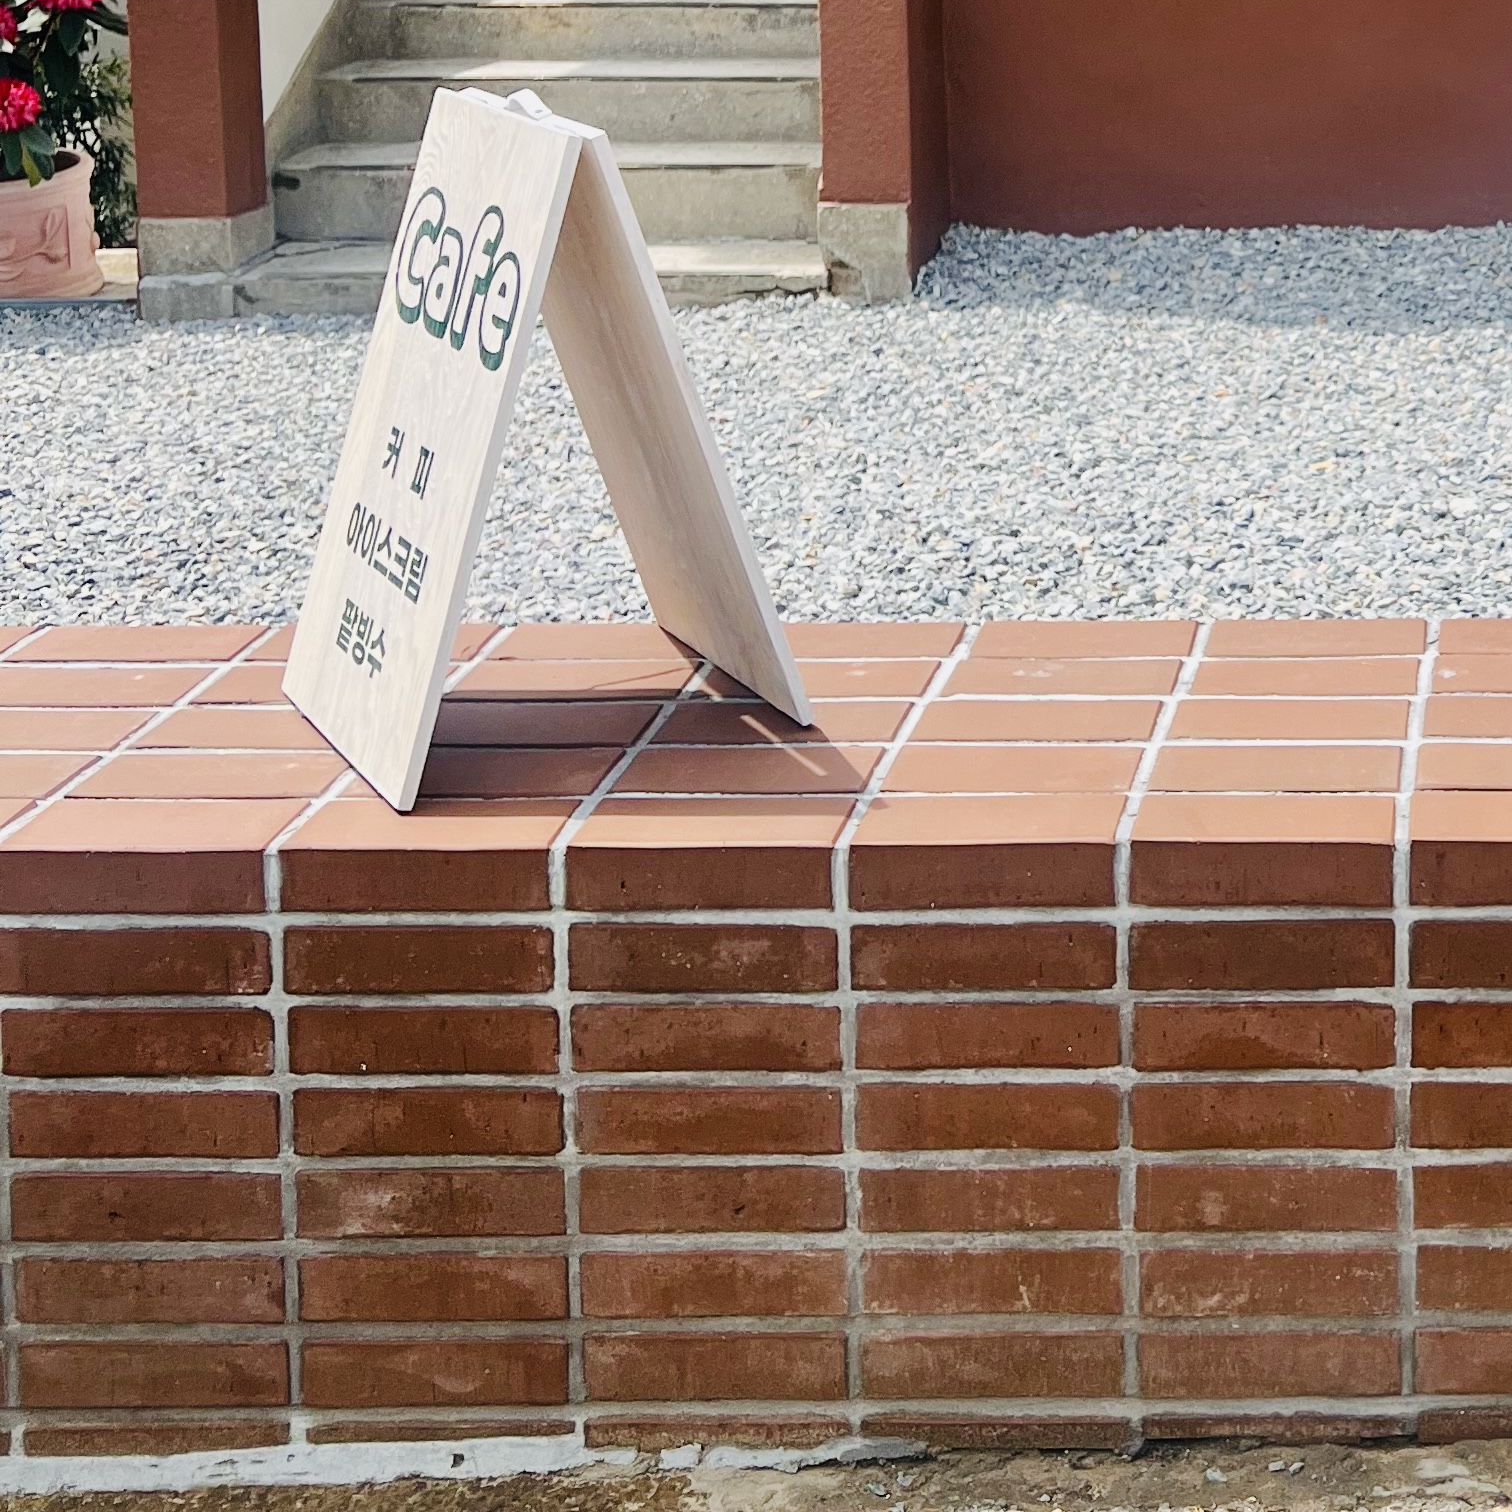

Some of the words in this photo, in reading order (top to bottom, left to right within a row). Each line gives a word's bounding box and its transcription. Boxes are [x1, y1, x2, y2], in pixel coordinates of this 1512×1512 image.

[395, 186, 521, 372] Cafe
[346, 502, 429, 605] 아이스크림
[335, 598, 386, 679] 팥빙수
